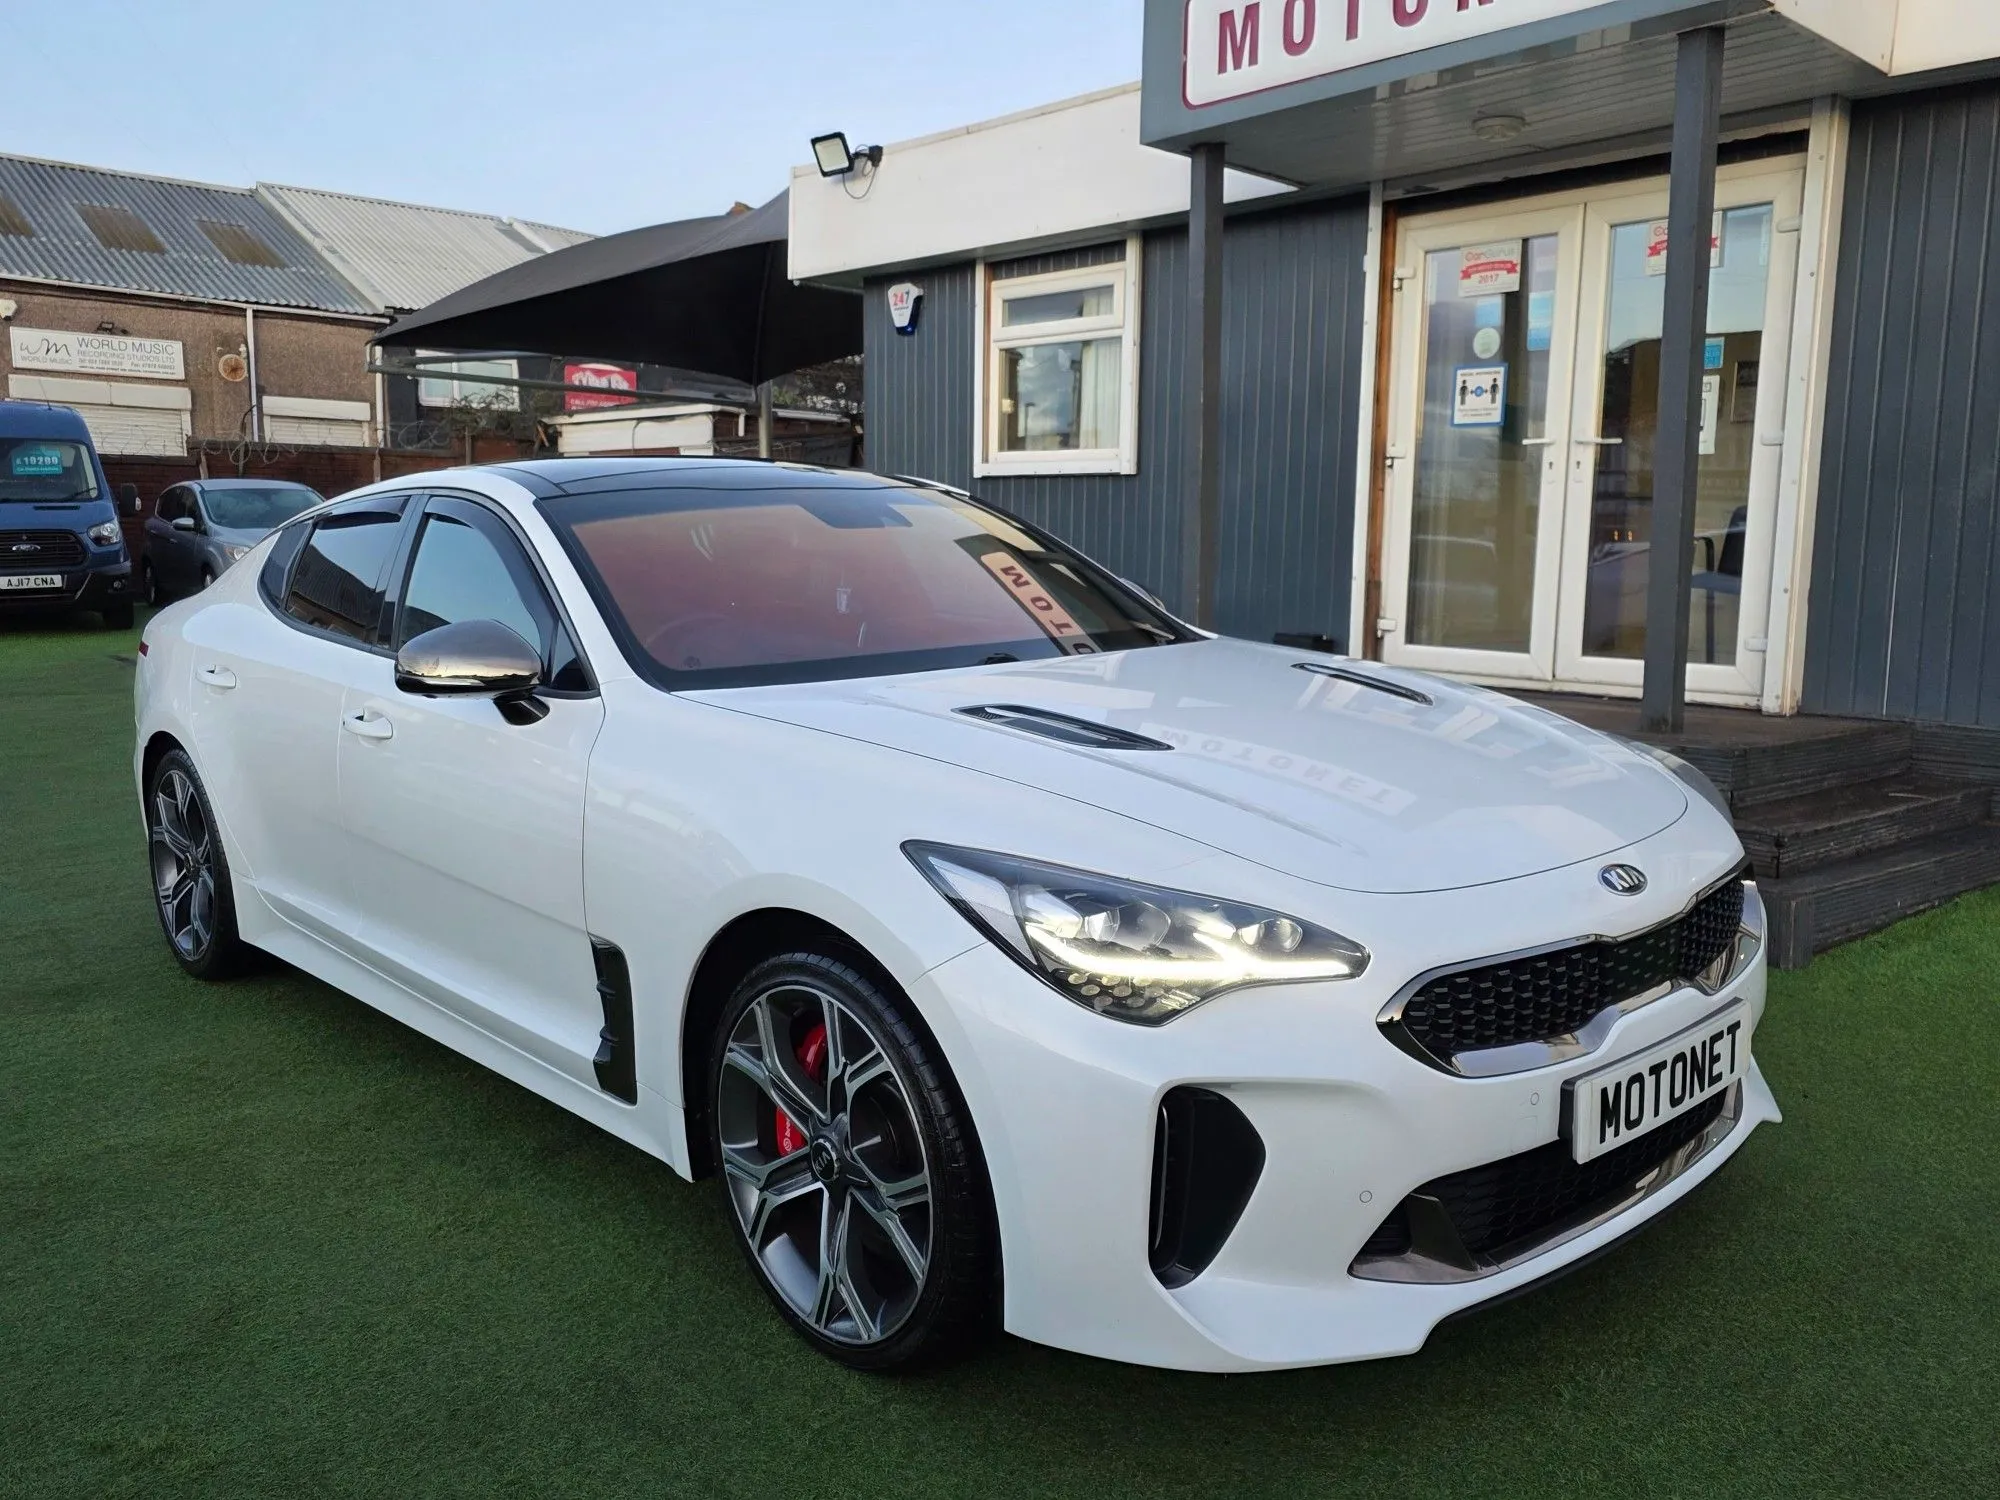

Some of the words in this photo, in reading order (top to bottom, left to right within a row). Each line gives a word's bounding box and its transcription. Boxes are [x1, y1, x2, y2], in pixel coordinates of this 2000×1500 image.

[1217, 0, 1494, 75] MOT
[77, 337, 128, 352] WORLD
[132, 341, 175, 356] MUSIC
[77, 350, 125, 360] RECORDING
[127, 353, 160, 363] STUDIOS
[161, 356, 175, 364] LTD
[7, 578, 30, 587] AJ17
[34, 577, 56, 587] CNA
[1603, 866, 1645, 890] KIA
[1599, 1020, 1741, 1144] MOTONET
